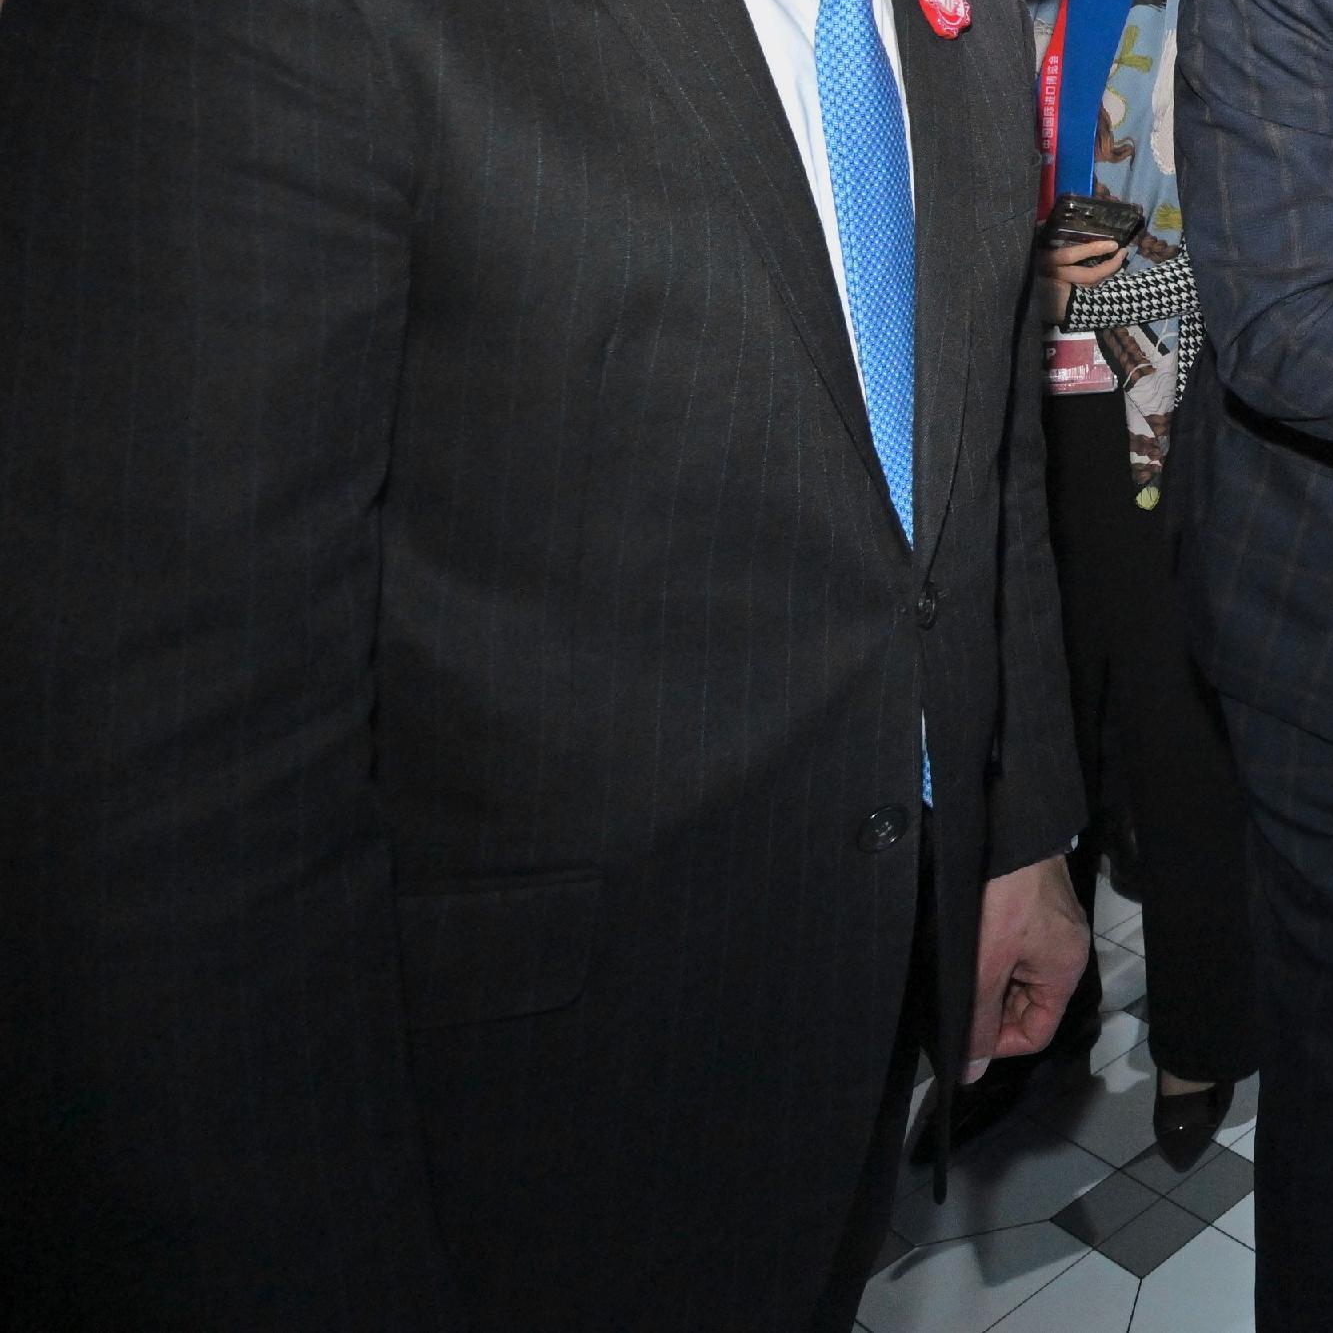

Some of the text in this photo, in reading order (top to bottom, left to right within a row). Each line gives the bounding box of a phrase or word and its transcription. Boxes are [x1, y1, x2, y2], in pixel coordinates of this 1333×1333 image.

[1042, 55, 1059, 149] 中国国际进口博览会
